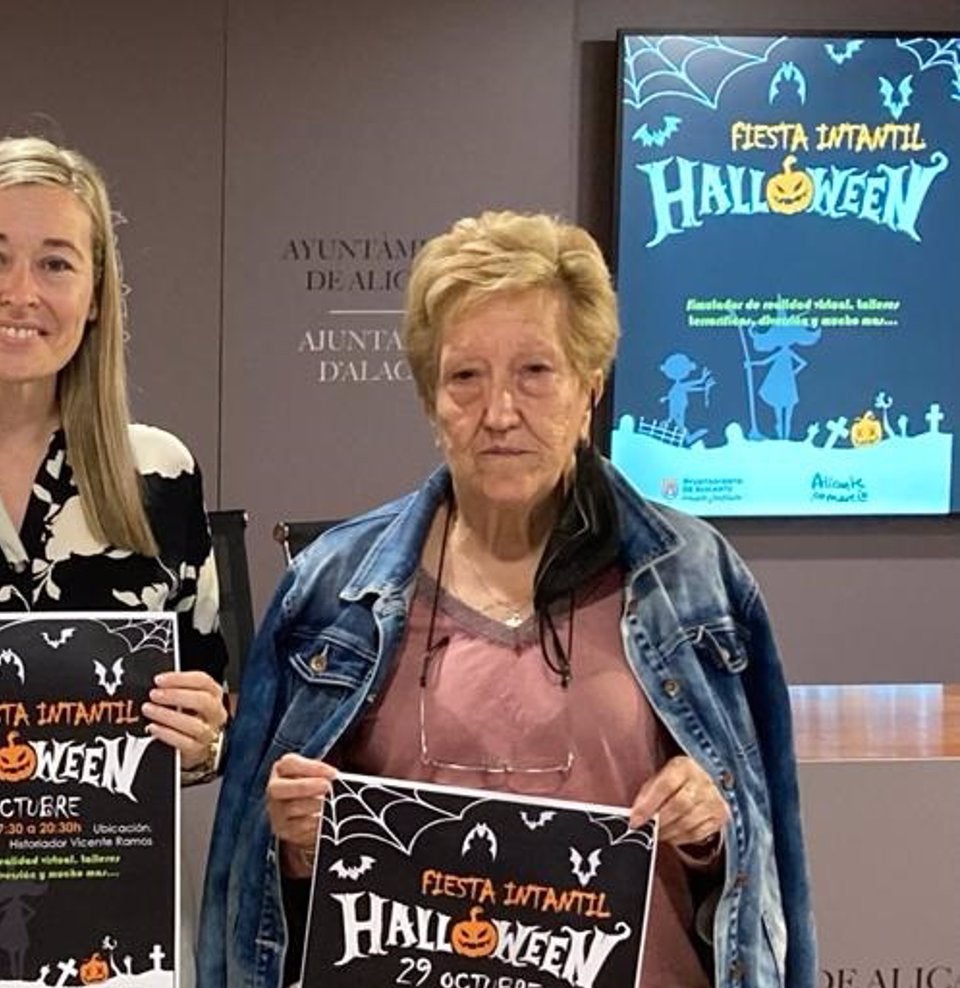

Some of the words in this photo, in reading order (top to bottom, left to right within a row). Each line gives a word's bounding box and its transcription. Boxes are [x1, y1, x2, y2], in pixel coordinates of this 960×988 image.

[732, 121, 808, 152] FIESTA
[635, 151, 949, 248] HALLOWEEN
[283, 237, 426, 260] AYUNTAM
[307, 271, 342, 291] DE
[349, 270, 408, 291] ALIC
[298, 329, 406, 351] AJUNTA
[319, 360, 412, 382] D'ALAC
[26, 825, 37, 834] a
[40, 822, 81, 834] 20:30h
[70, 837, 113, 848] Vicente
[115, 836, 153, 847] Ramos
[421, 869, 496, 904] FIESTA
[396, 957, 432, 987] 29
